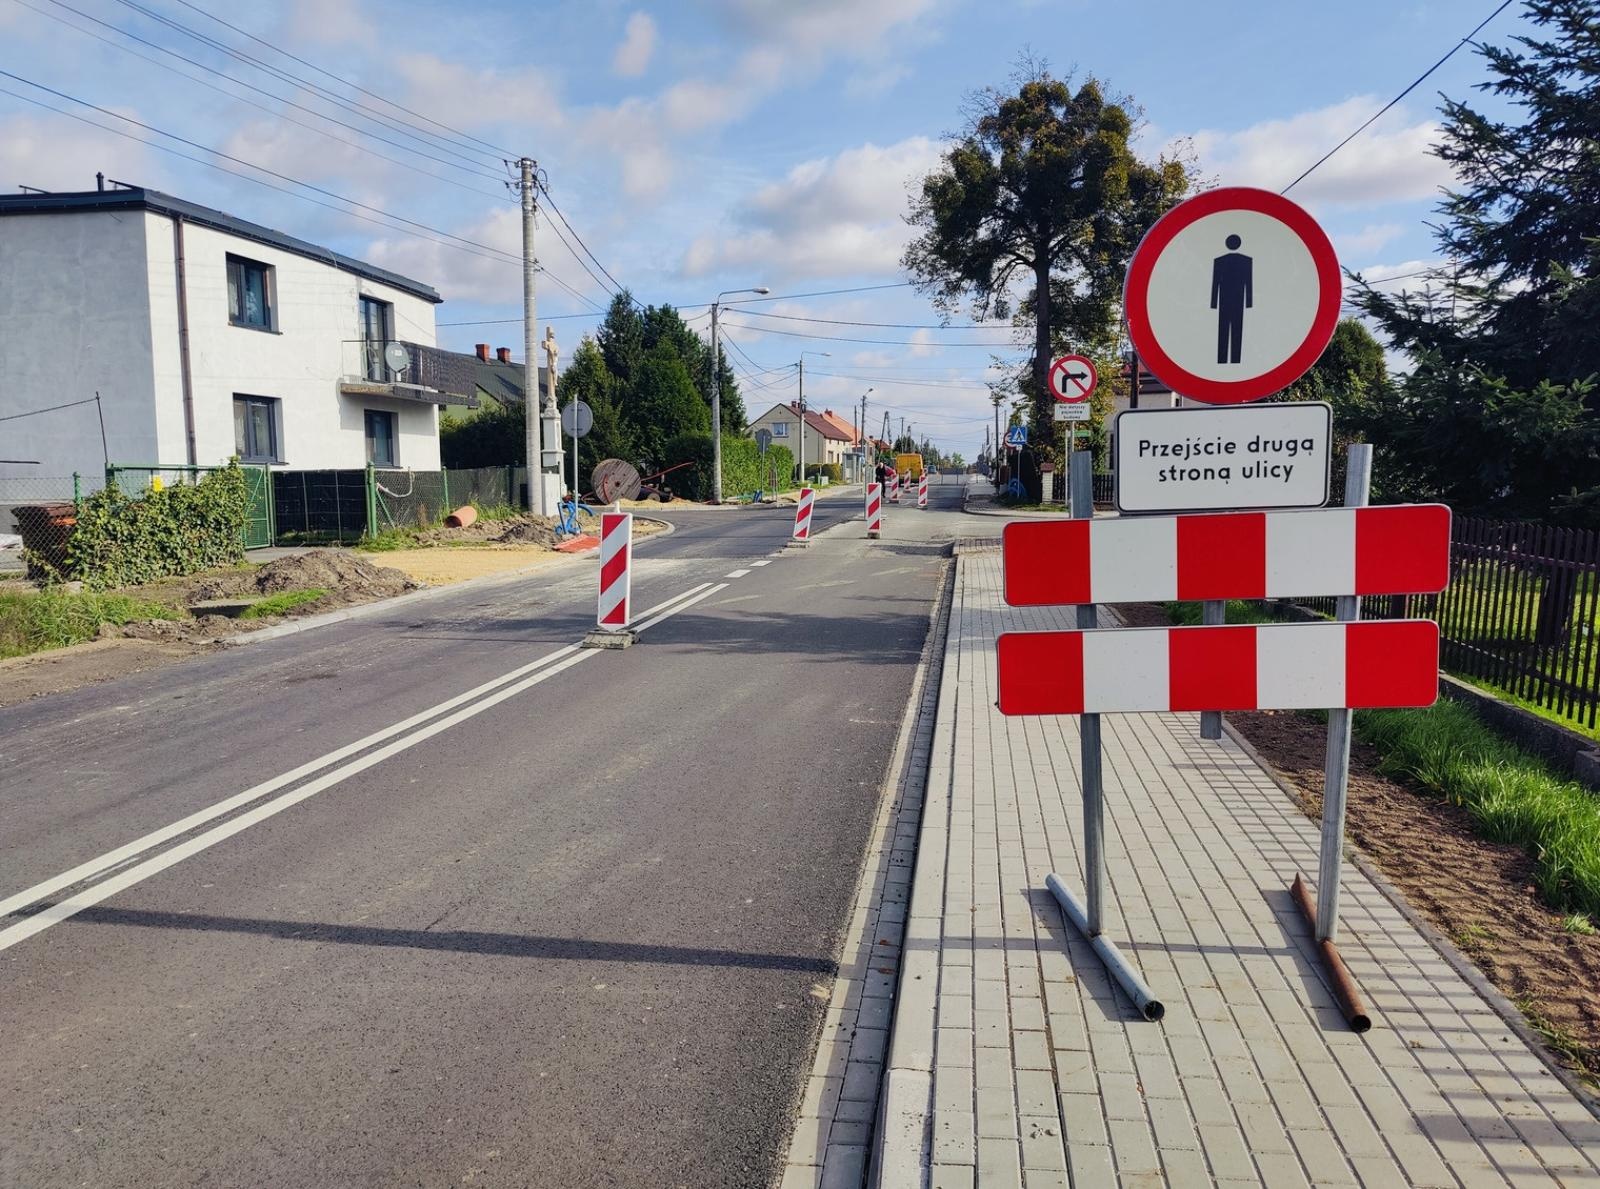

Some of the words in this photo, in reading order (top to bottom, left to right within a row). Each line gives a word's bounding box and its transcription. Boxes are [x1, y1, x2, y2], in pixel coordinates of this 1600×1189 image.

[1139, 436, 1237, 461] Przejście
[1247, 435, 1314, 457] drugą
[1158, 464, 1231, 485] stroną
[1242, 460, 1294, 483] ulicy
